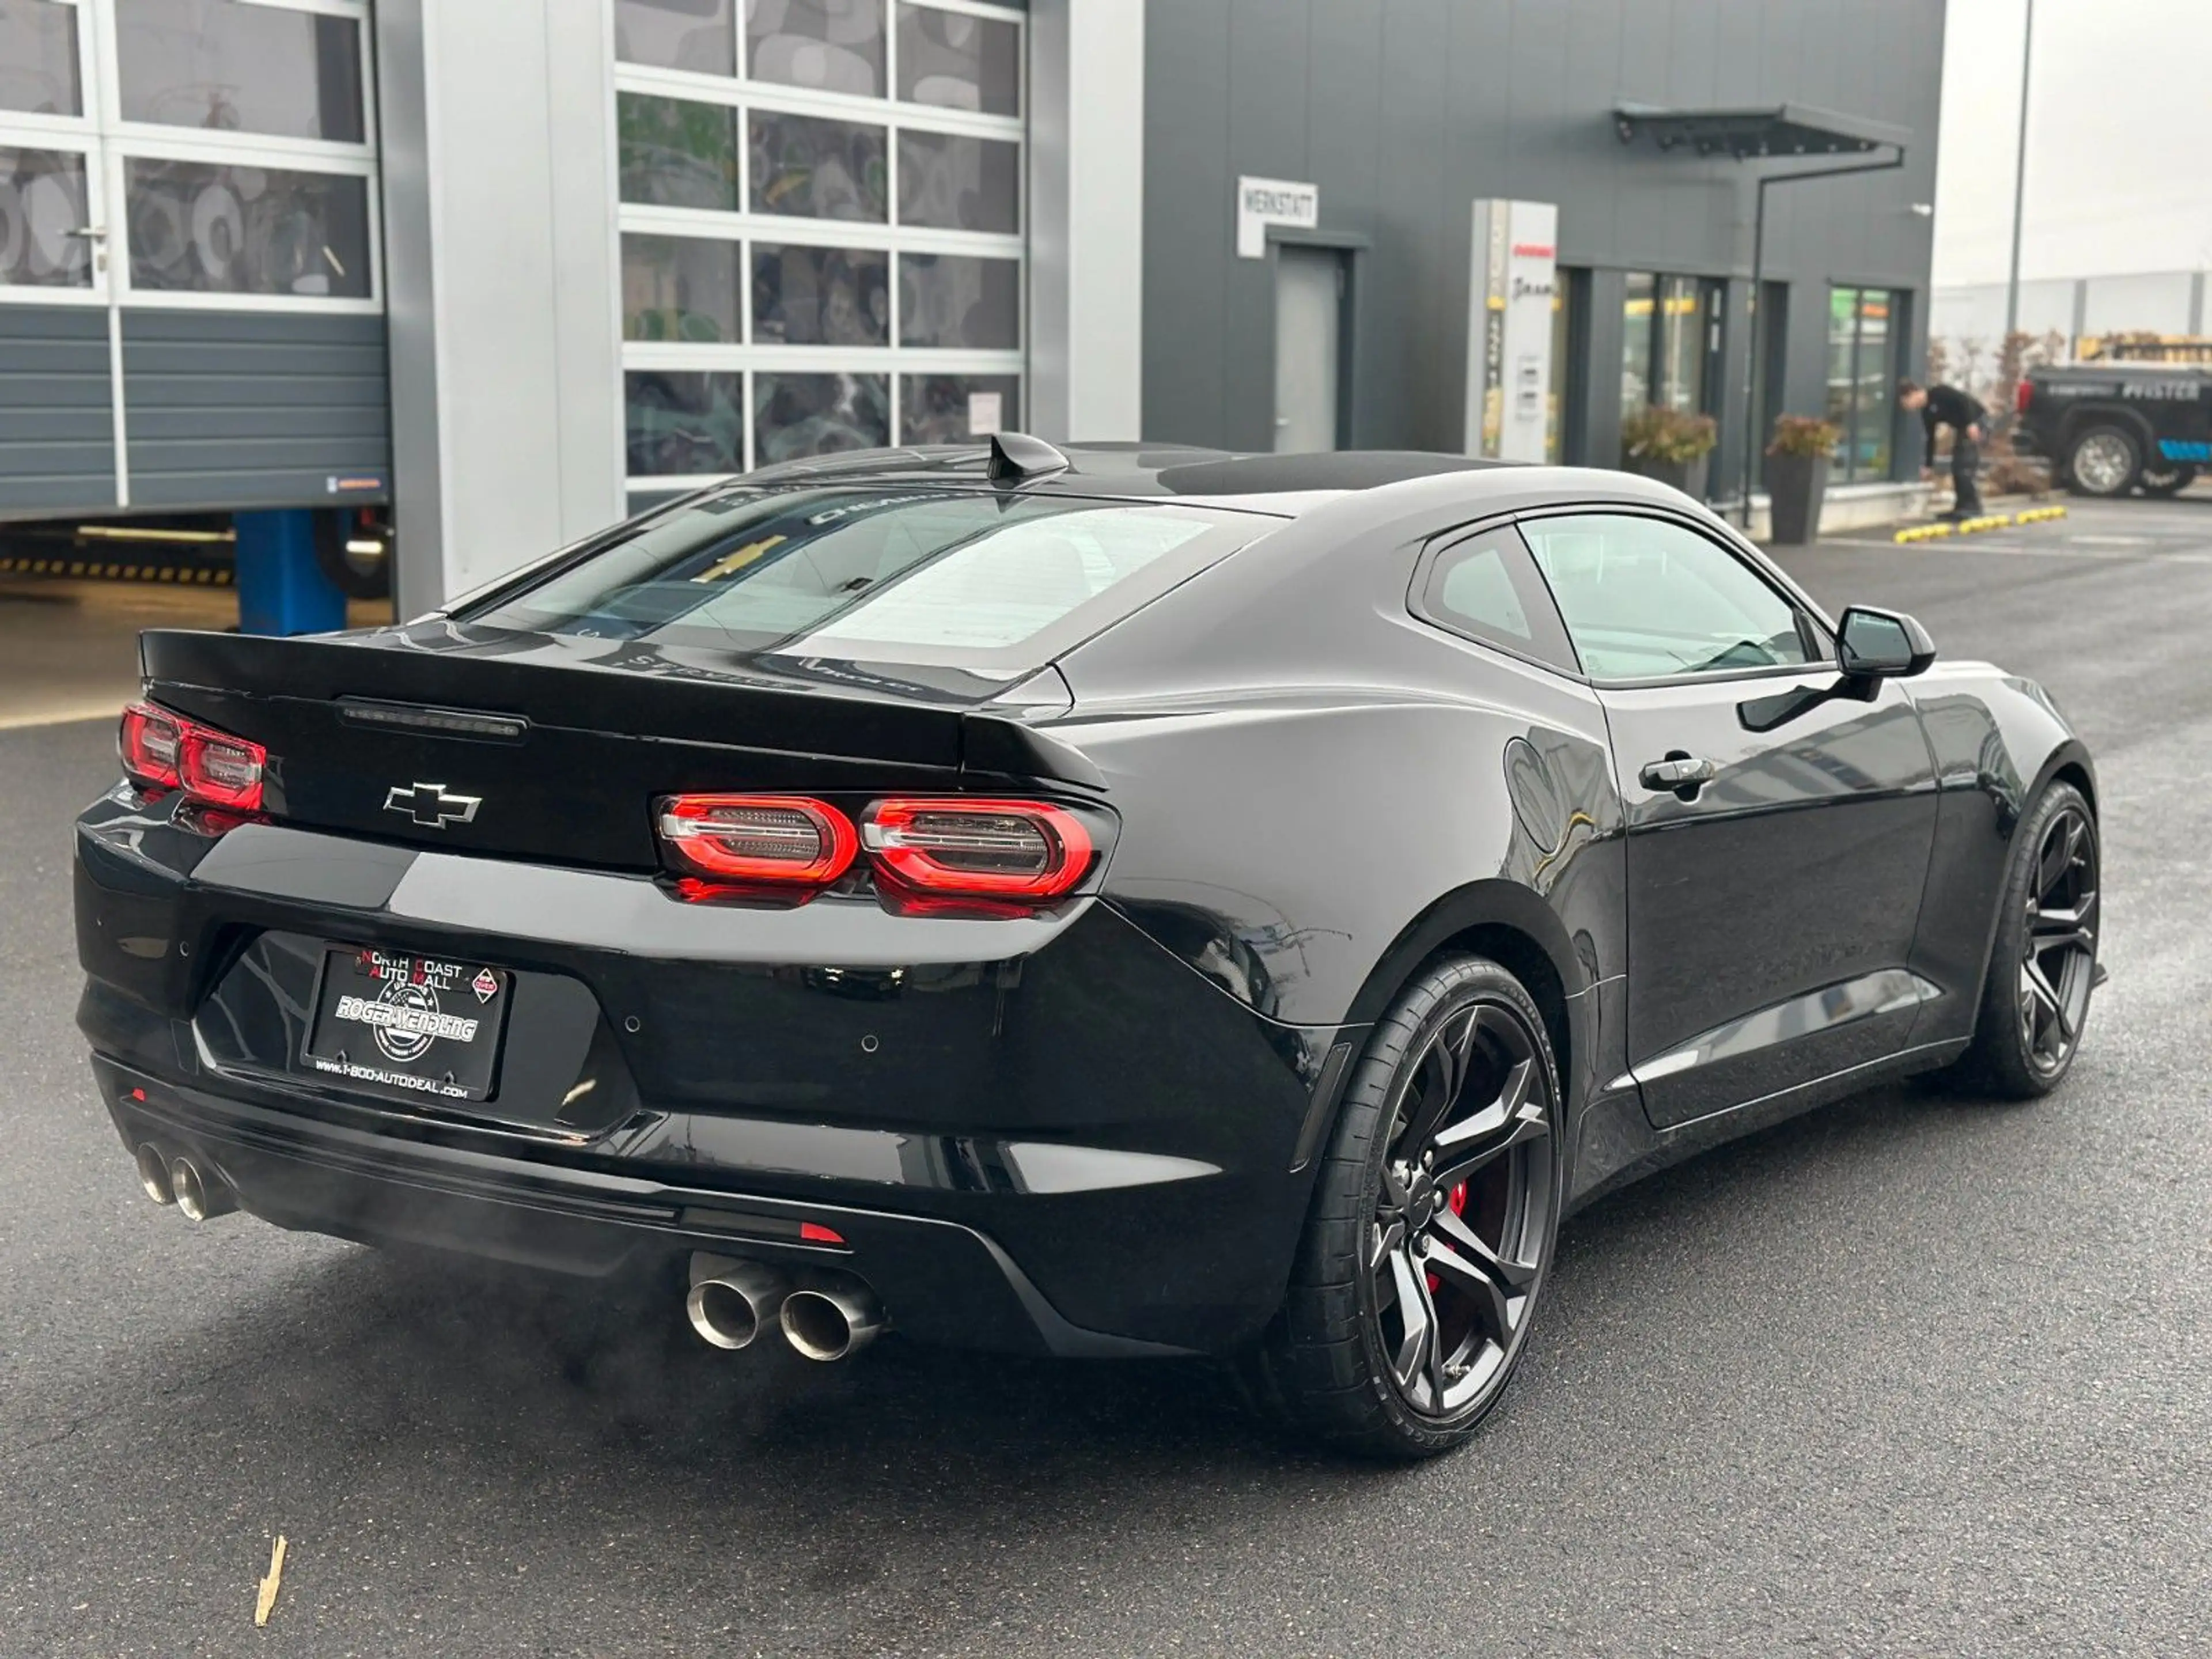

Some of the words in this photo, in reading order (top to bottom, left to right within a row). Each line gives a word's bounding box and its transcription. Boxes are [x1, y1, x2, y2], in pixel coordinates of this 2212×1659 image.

[368, 965, 408, 982] AUTO
[412, 971, 451, 990] MALL
[415, 956, 462, 978] COAST
